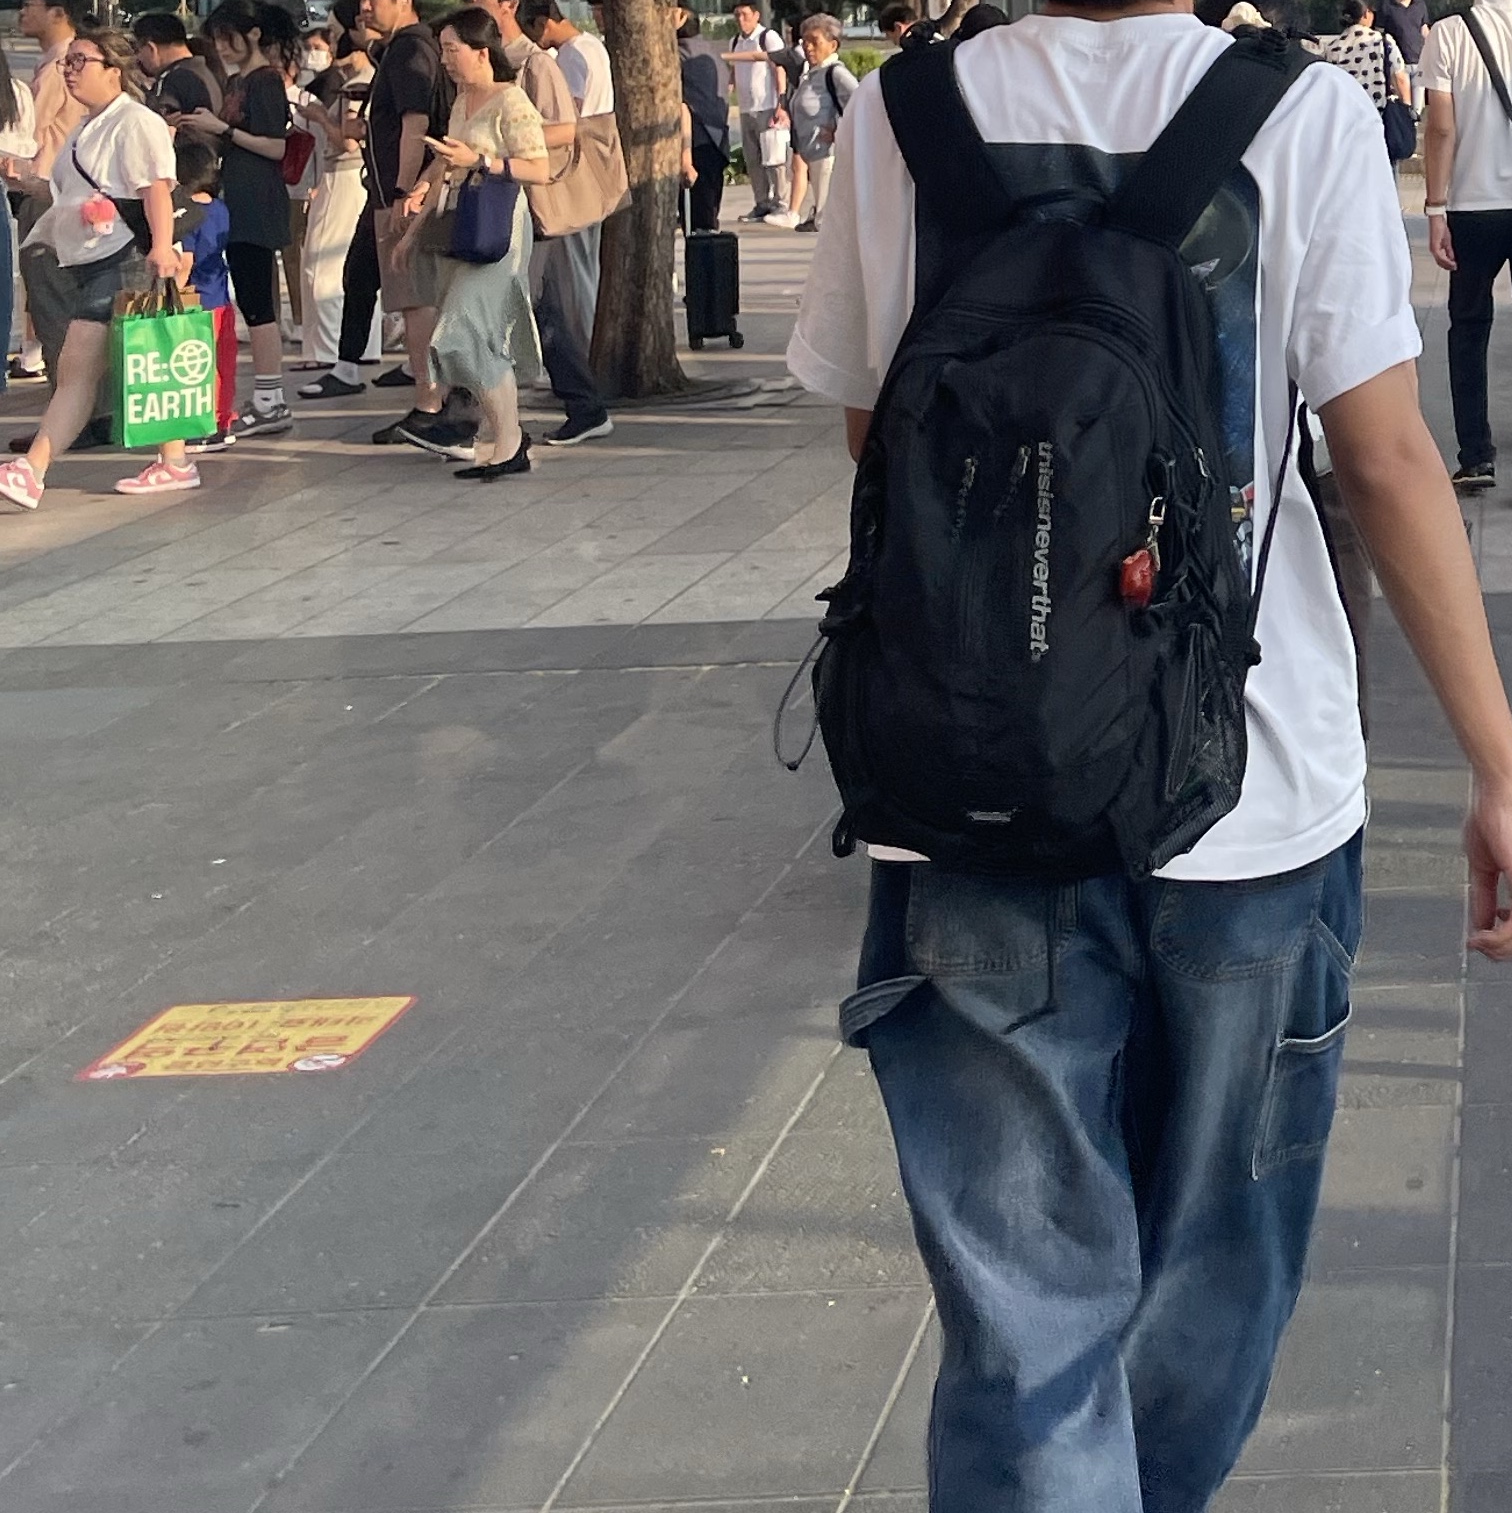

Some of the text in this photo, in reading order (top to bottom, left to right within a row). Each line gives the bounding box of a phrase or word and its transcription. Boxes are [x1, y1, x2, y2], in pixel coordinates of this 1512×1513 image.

[127, 351, 170, 386] RE:
[127, 384, 213, 425] EARTH
[1030, 440, 1055, 660] thisisneverthat
